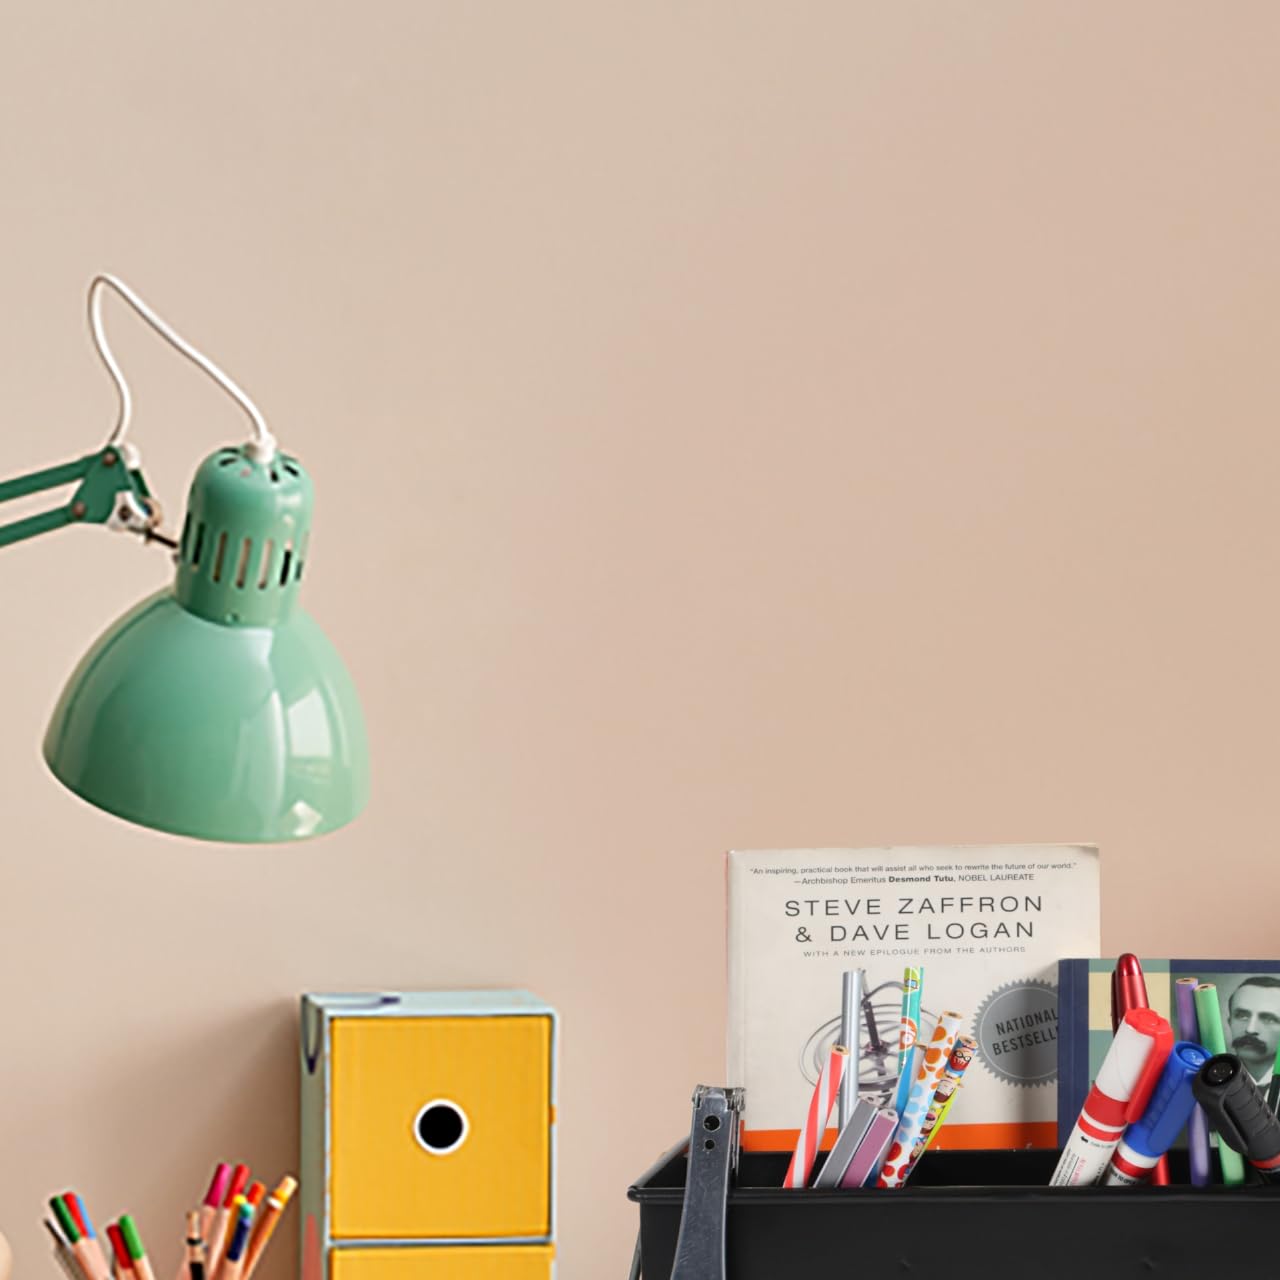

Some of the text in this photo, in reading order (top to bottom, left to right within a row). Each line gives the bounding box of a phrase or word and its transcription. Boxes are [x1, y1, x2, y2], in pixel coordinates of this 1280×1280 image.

[800, 865, 833, 874] practical
[834, 865, 852, 873] book
[855, 865, 869, 873] that
[885, 864, 907, 873] assist
[908, 864, 917, 872] all
[918, 864, 934, 872] who
[936, 863, 953, 872] seek
[955, 863, 963, 871] to
[964, 863, 990, 871] rewrite
[991, 863, 1003, 871] the
[1004, 863, 1026, 871] future
[1027, 862, 1036, 870] of
[850, 876, 886, 884] Emeritus
[888, 875, 931, 884] Desmond
[934, 874, 957, 883] Tutu,
[958, 874, 989, 882] NOBEL
[990, 873, 1035, 882] LAUREATE
[784, 895, 1042, 917] STEVE ZAFFRON
[795, 921, 1033, 943] & DAVE LOGAN
[803, 950, 829, 958] WITH
[843, 949, 866, 957] NEW
[870, 948, 920, 957] EPILOGUE
[923, 947, 952, 955] FROM
[957, 947, 975, 955] THE
[979, 946, 1026, 954] AUTHORS
[995, 1007, 1059, 1036] NATIONAL
[992, 1025, 1059, 1056] BESTSELL
